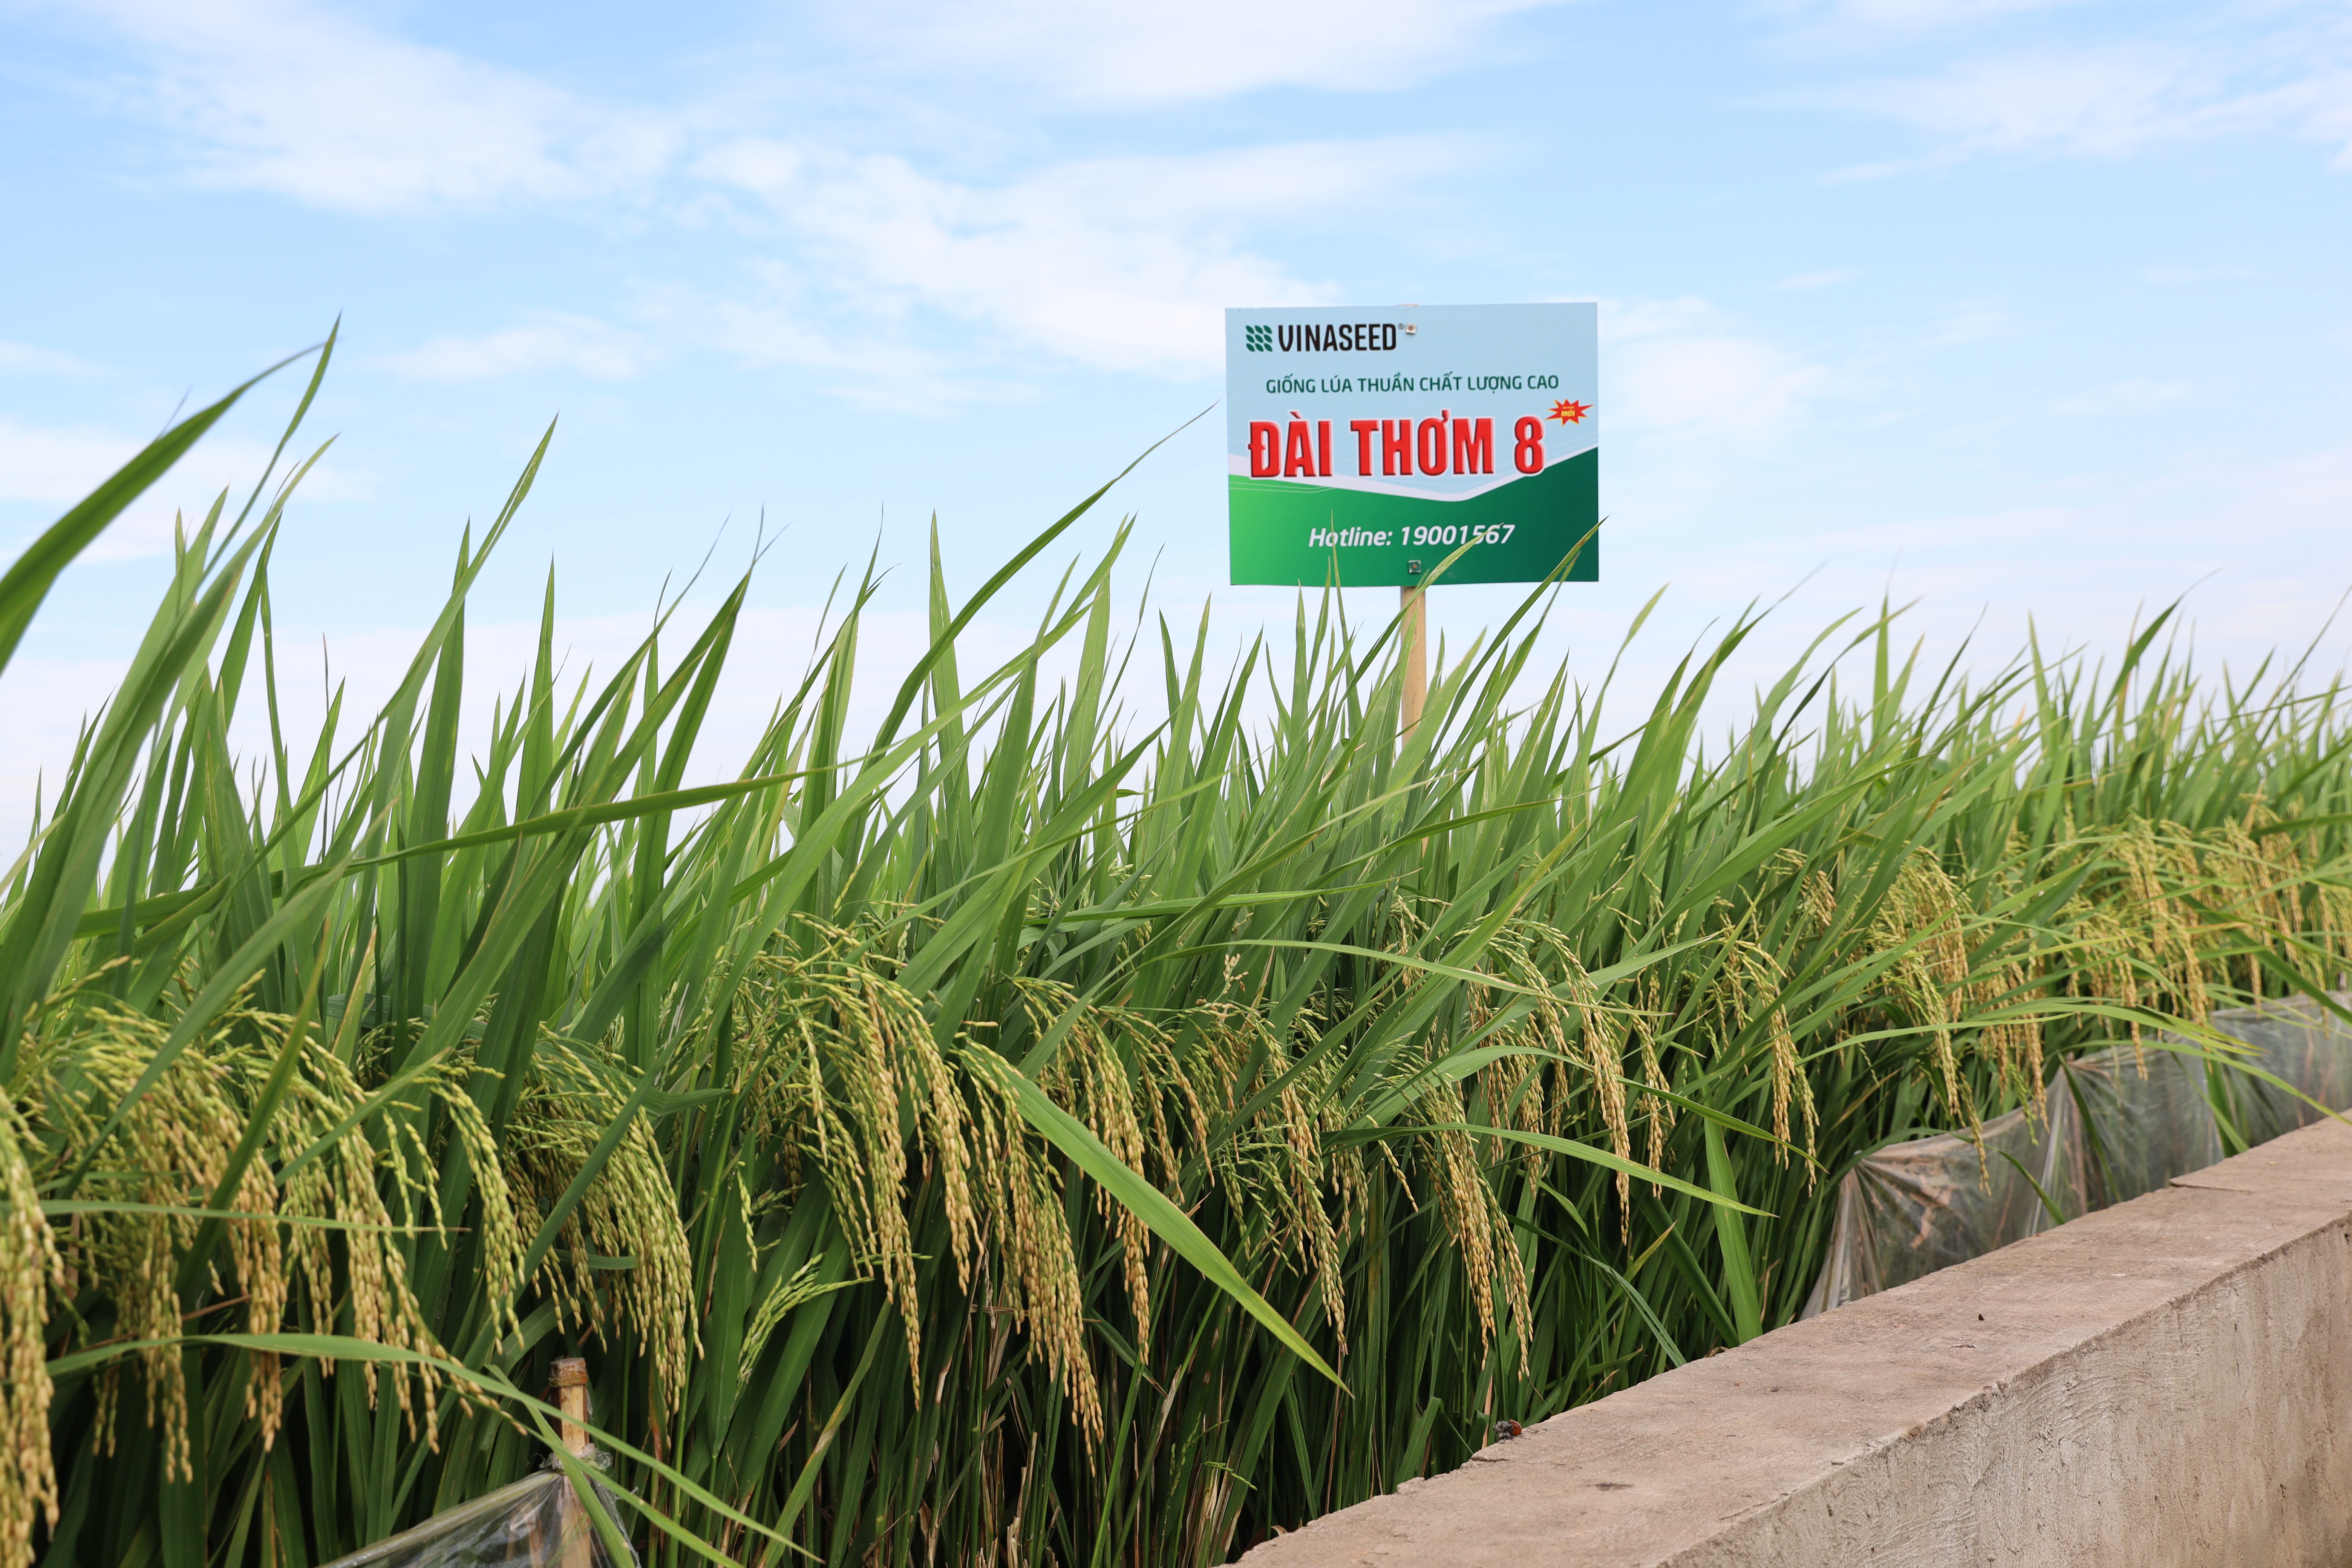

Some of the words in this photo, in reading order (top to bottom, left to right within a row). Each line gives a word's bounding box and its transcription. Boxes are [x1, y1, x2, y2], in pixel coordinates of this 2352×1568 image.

[1278, 323, 1396, 352] VINASEED
[1266, 374, 1316, 393] GIỐNG
[1321, 375, 1352, 393] LÚA
[1357, 372, 1414, 392] THUẦN
[1419, 371, 1462, 391] CHẤT
[1468, 375, 1522, 394] LƯỢNG
[1527, 375, 1559, 389] CAO
[1247, 411, 1333, 478] ĐÀI
[1350, 409, 1494, 477] THƠM
[1514, 416, 1545, 474] 8
[1309, 526, 1393, 547] Hotline:
[1401, 524, 1516, 546] 19001567
